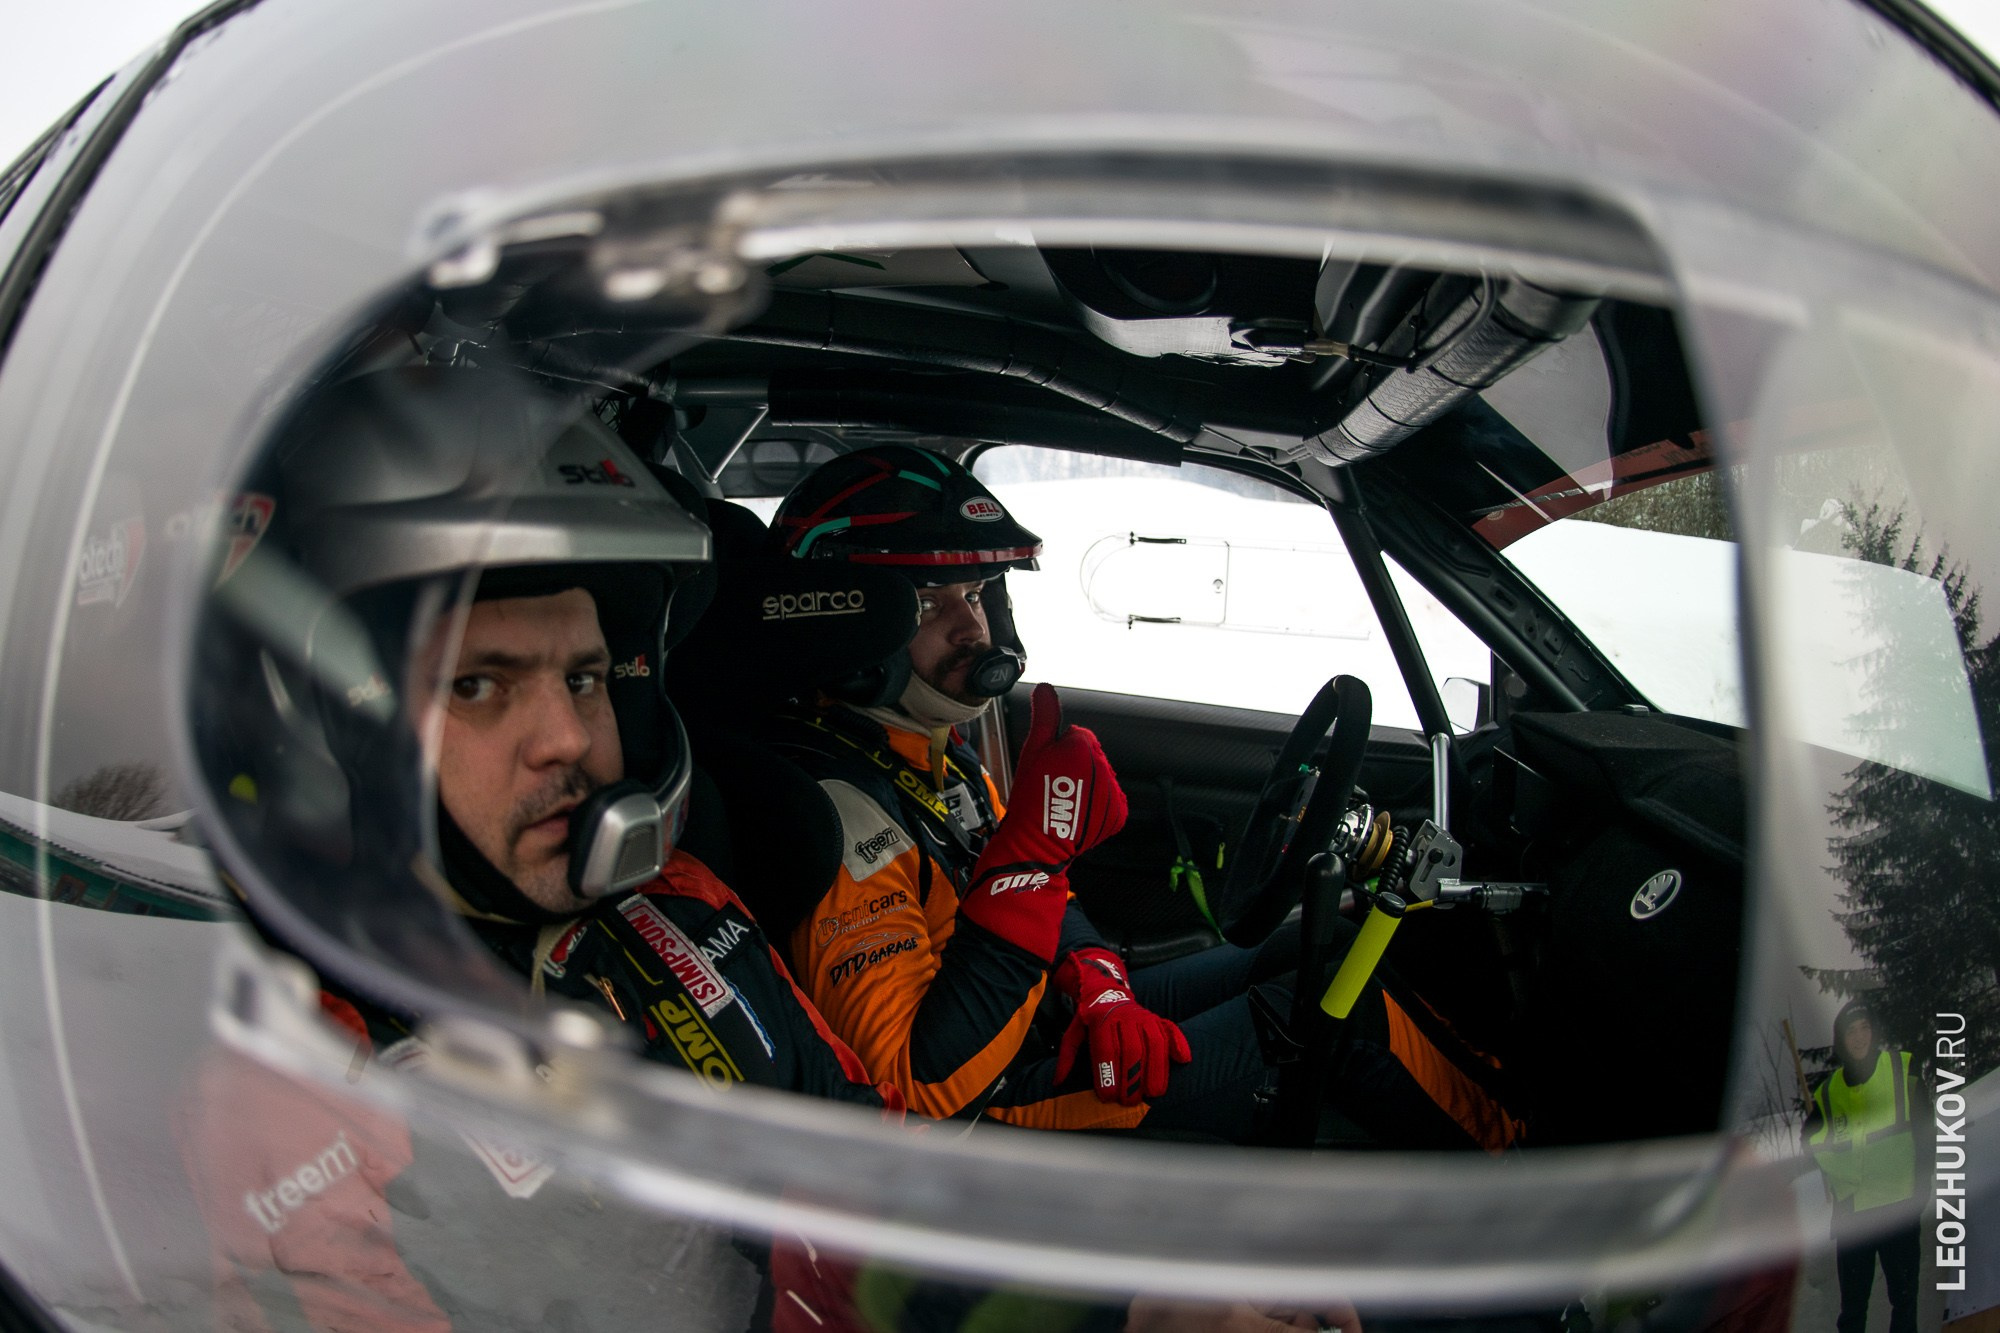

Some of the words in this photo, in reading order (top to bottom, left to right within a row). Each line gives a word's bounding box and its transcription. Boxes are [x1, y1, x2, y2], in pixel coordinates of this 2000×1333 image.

[966, 502, 1001, 516] BELL
[762, 589, 865, 620] sparco
[614, 654, 650, 679] stilo
[898, 769, 949, 815] OMP
[1049, 775, 1076, 839] OMP
[854, 827, 900, 863] freem
[629, 911, 718, 1004] SIMPSON
[700, 918, 750, 969] AMA
[829, 952, 867, 987] DTD
[868, 937, 919, 965] GARAGE
[659, 999, 734, 1092] OMP
[1101, 1061, 1113, 1087] OMP
